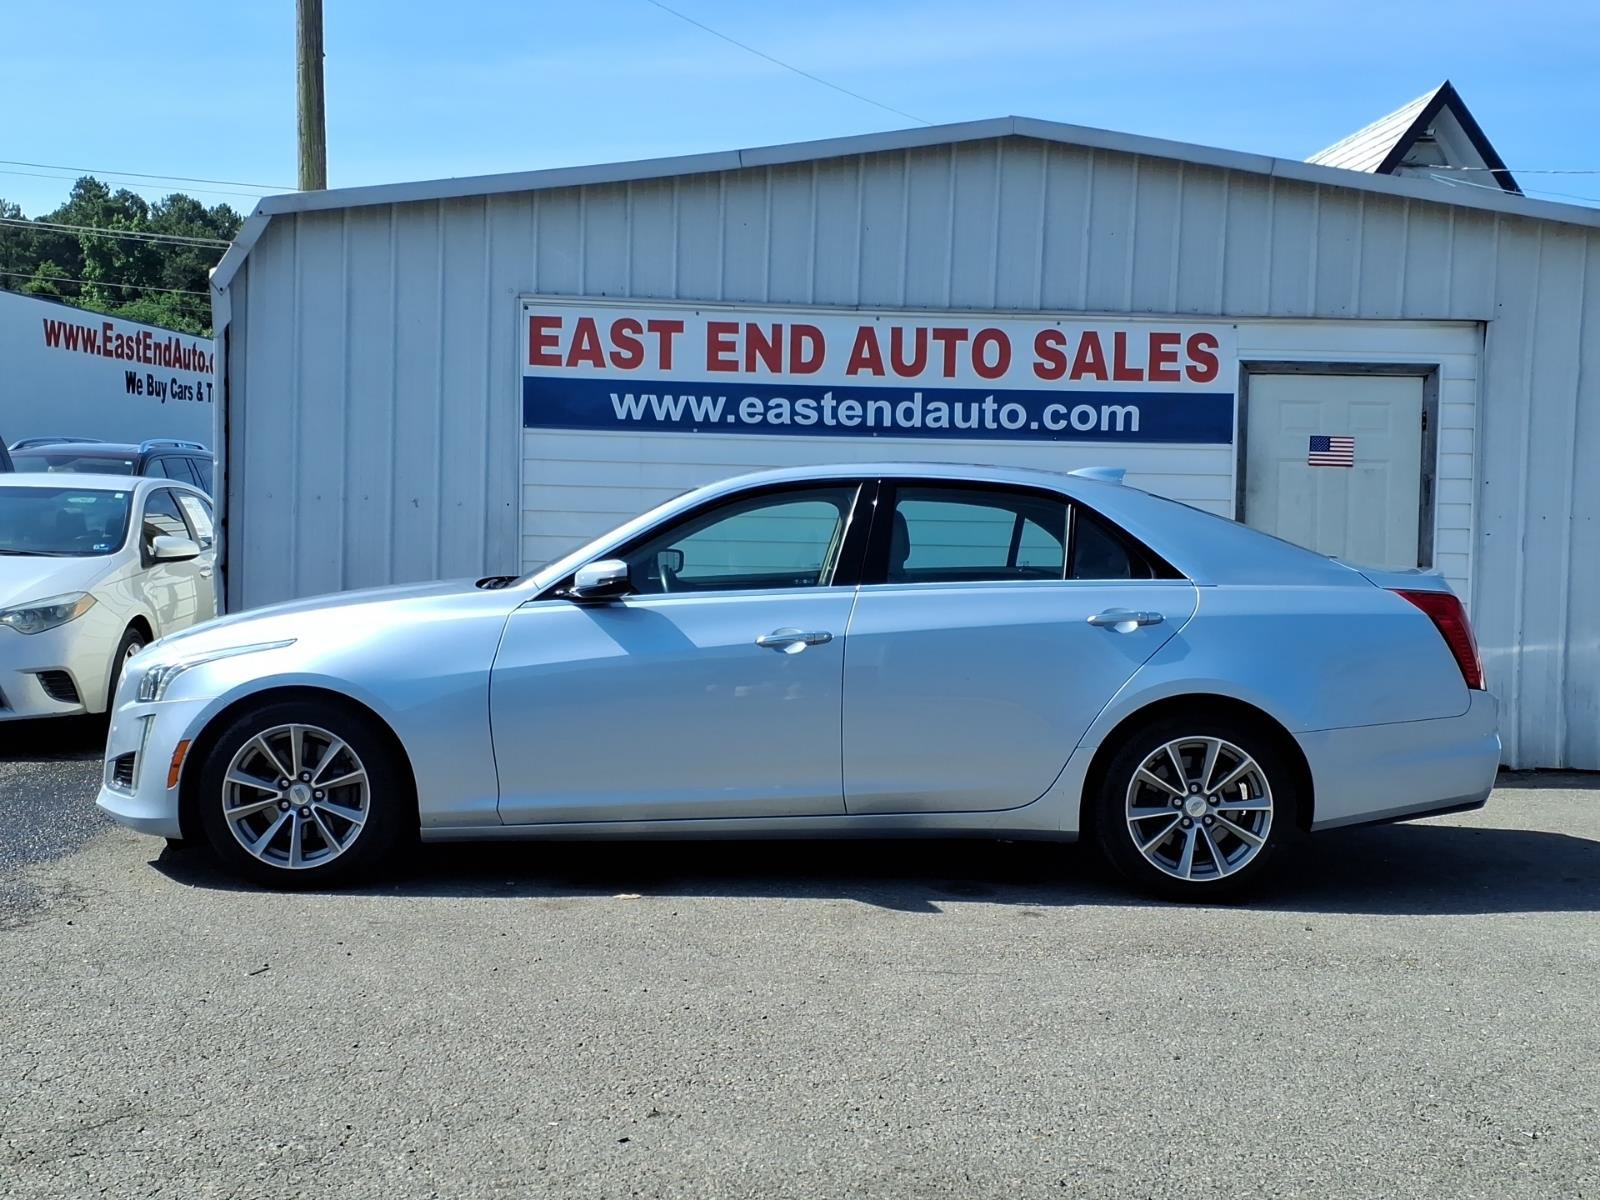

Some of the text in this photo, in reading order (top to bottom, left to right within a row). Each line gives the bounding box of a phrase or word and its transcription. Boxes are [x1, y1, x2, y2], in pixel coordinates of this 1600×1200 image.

[528, 315, 1220, 384] EAST END AUTO SALES
[125, 370, 143, 396] We
[147, 373, 167, 404] Buy
[170, 377, 194, 402] Cars
[196, 381, 203, 402] &
[610, 391, 1140, 432] www.eastendauto.com
